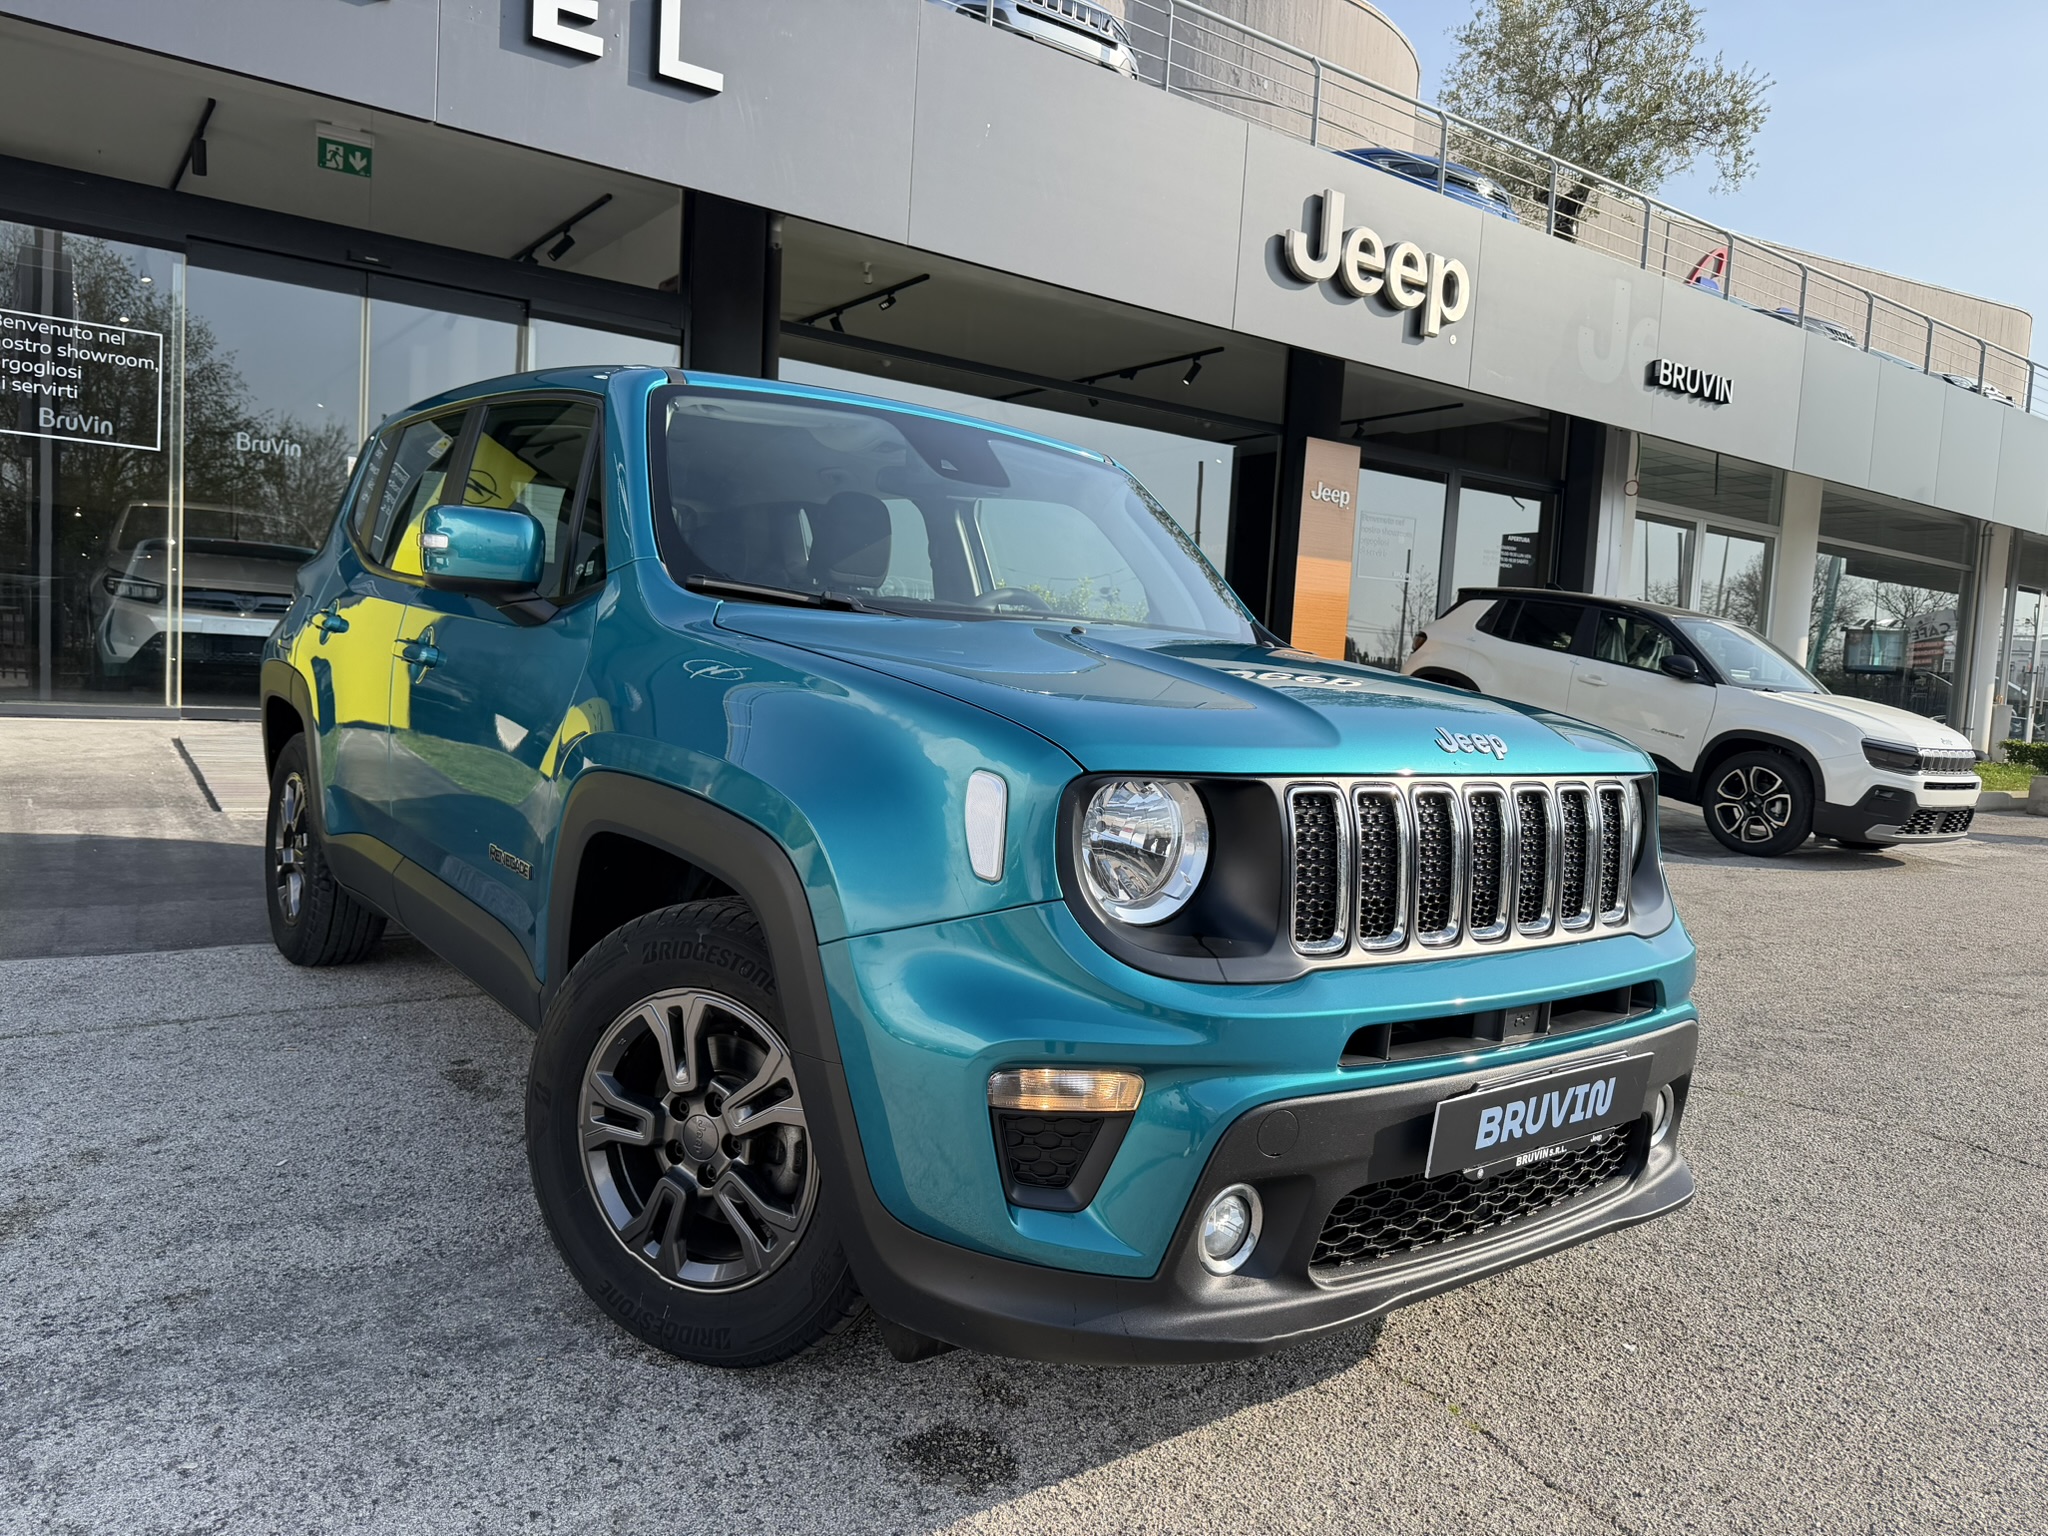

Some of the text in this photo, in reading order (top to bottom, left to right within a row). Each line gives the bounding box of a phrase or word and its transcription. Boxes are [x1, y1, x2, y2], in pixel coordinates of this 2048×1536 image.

[1284, 188, 1471, 338] Jeep
[0, 314, 126, 346] envenuto nel
[1, 338, 159, 375] ostro showroom,
[1, 358, 83, 380] rgogliosi
[12, 379, 79, 399] servirti
[1658, 359, 1736, 404] BRUVIN
[38, 406, 114, 436] BruVin
[236, 431, 302, 458] BruVin
[1310, 481, 1351, 508] Jeep
[1507, 535, 1531, 544] APERTURA
[1434, 726, 1509, 760] Jeep
[488, 842, 531, 881] RENEGADE
[1474, 1076, 1617, 1150] BRUVIN
[1515, 1147, 1550, 1167] BRUVIN
